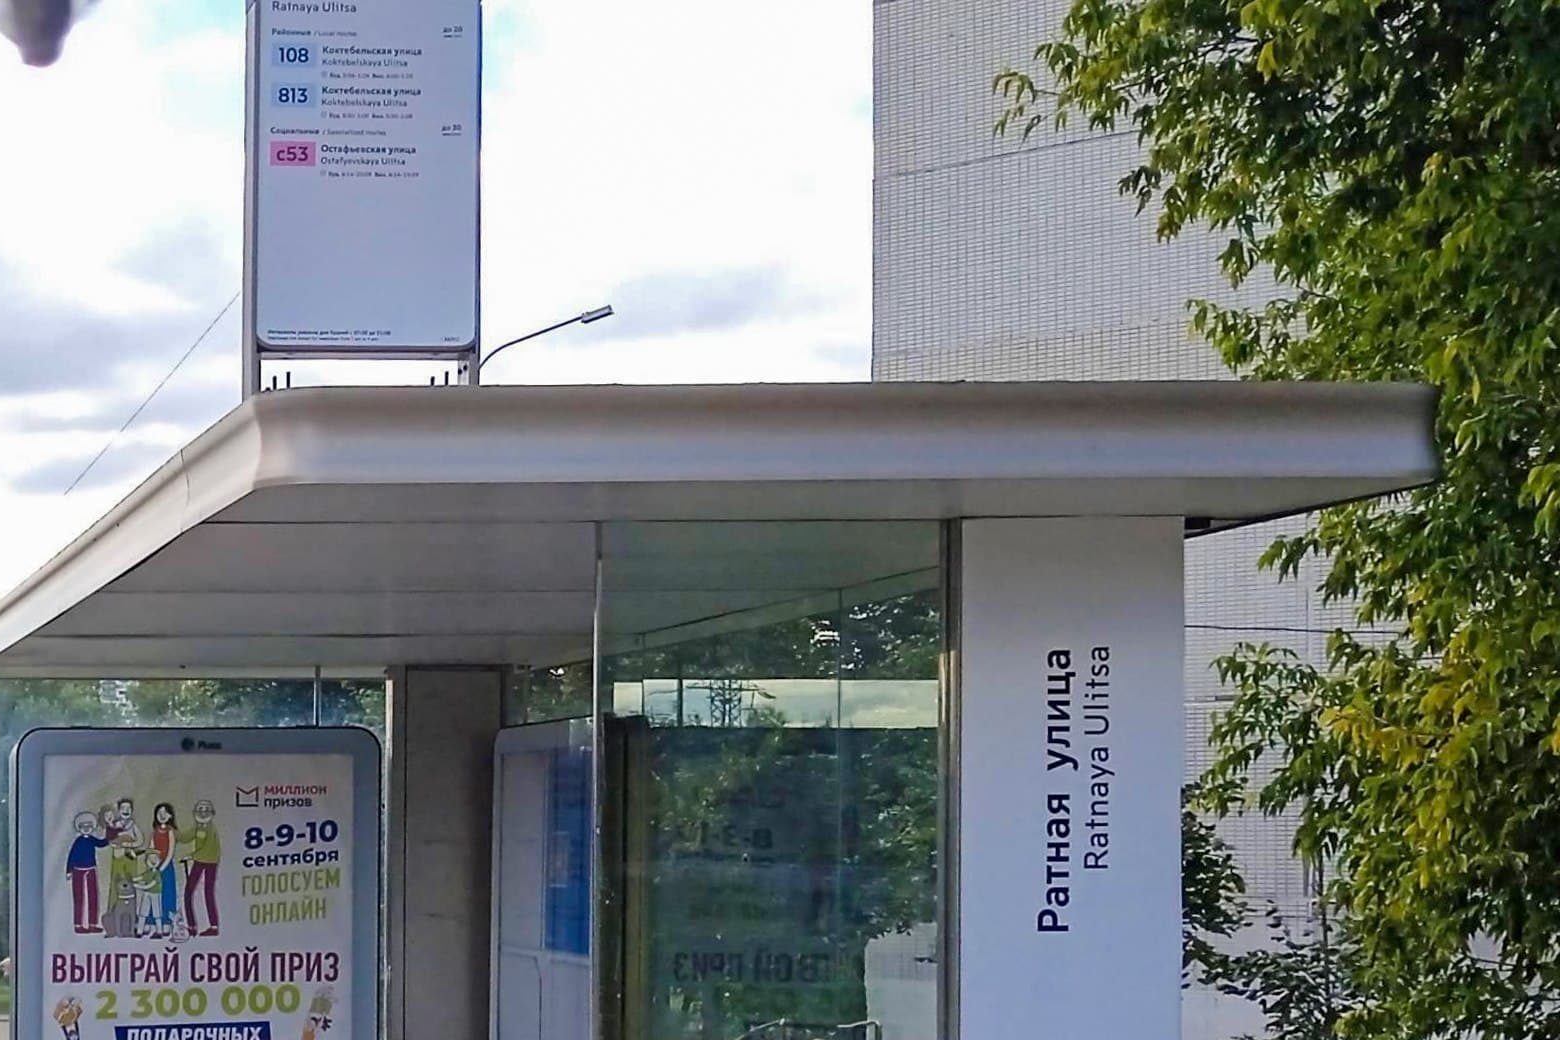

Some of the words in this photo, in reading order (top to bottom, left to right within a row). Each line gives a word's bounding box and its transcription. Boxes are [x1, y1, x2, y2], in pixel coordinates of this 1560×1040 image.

[272, 0, 319, 14] Ratnaya
[322, 1, 357, 13] Ulitsa
[278, 46, 310, 63] 108
[322, 46, 392, 55] Коктебельская
[392, 48, 422, 57] улица
[277, 86, 309, 103] 813
[321, 86, 392, 95] Коктебельская
[392, 88, 422, 97] улица
[321, 144, 386, 154] Остафьевская
[388, 146, 417, 155] улица
[1083, 646, 1109, 735] Ulitsa
[1047, 649, 1078, 771] улица
[264, 798, 313, 809] призов
[1084, 747, 1115, 869] Ratnaya
[244, 819, 339, 850] 8-9-10
[242, 848, 339, 868] сентября
[1037, 794, 1070, 932] Ратная
[241, 867, 341, 898] ГОЛОСУЕМ
[249, 896, 327, 926] ОНЛАЙН
[51, 946, 180, 984] ВЫИГРАЙ
[190, 946, 260, 983] СВОЙ
[271, 952, 339, 983] ПРИЗ
[95, 989, 118, 1020] 2
[130, 987, 208, 1019] 300
[221, 984, 301, 1016] 000
